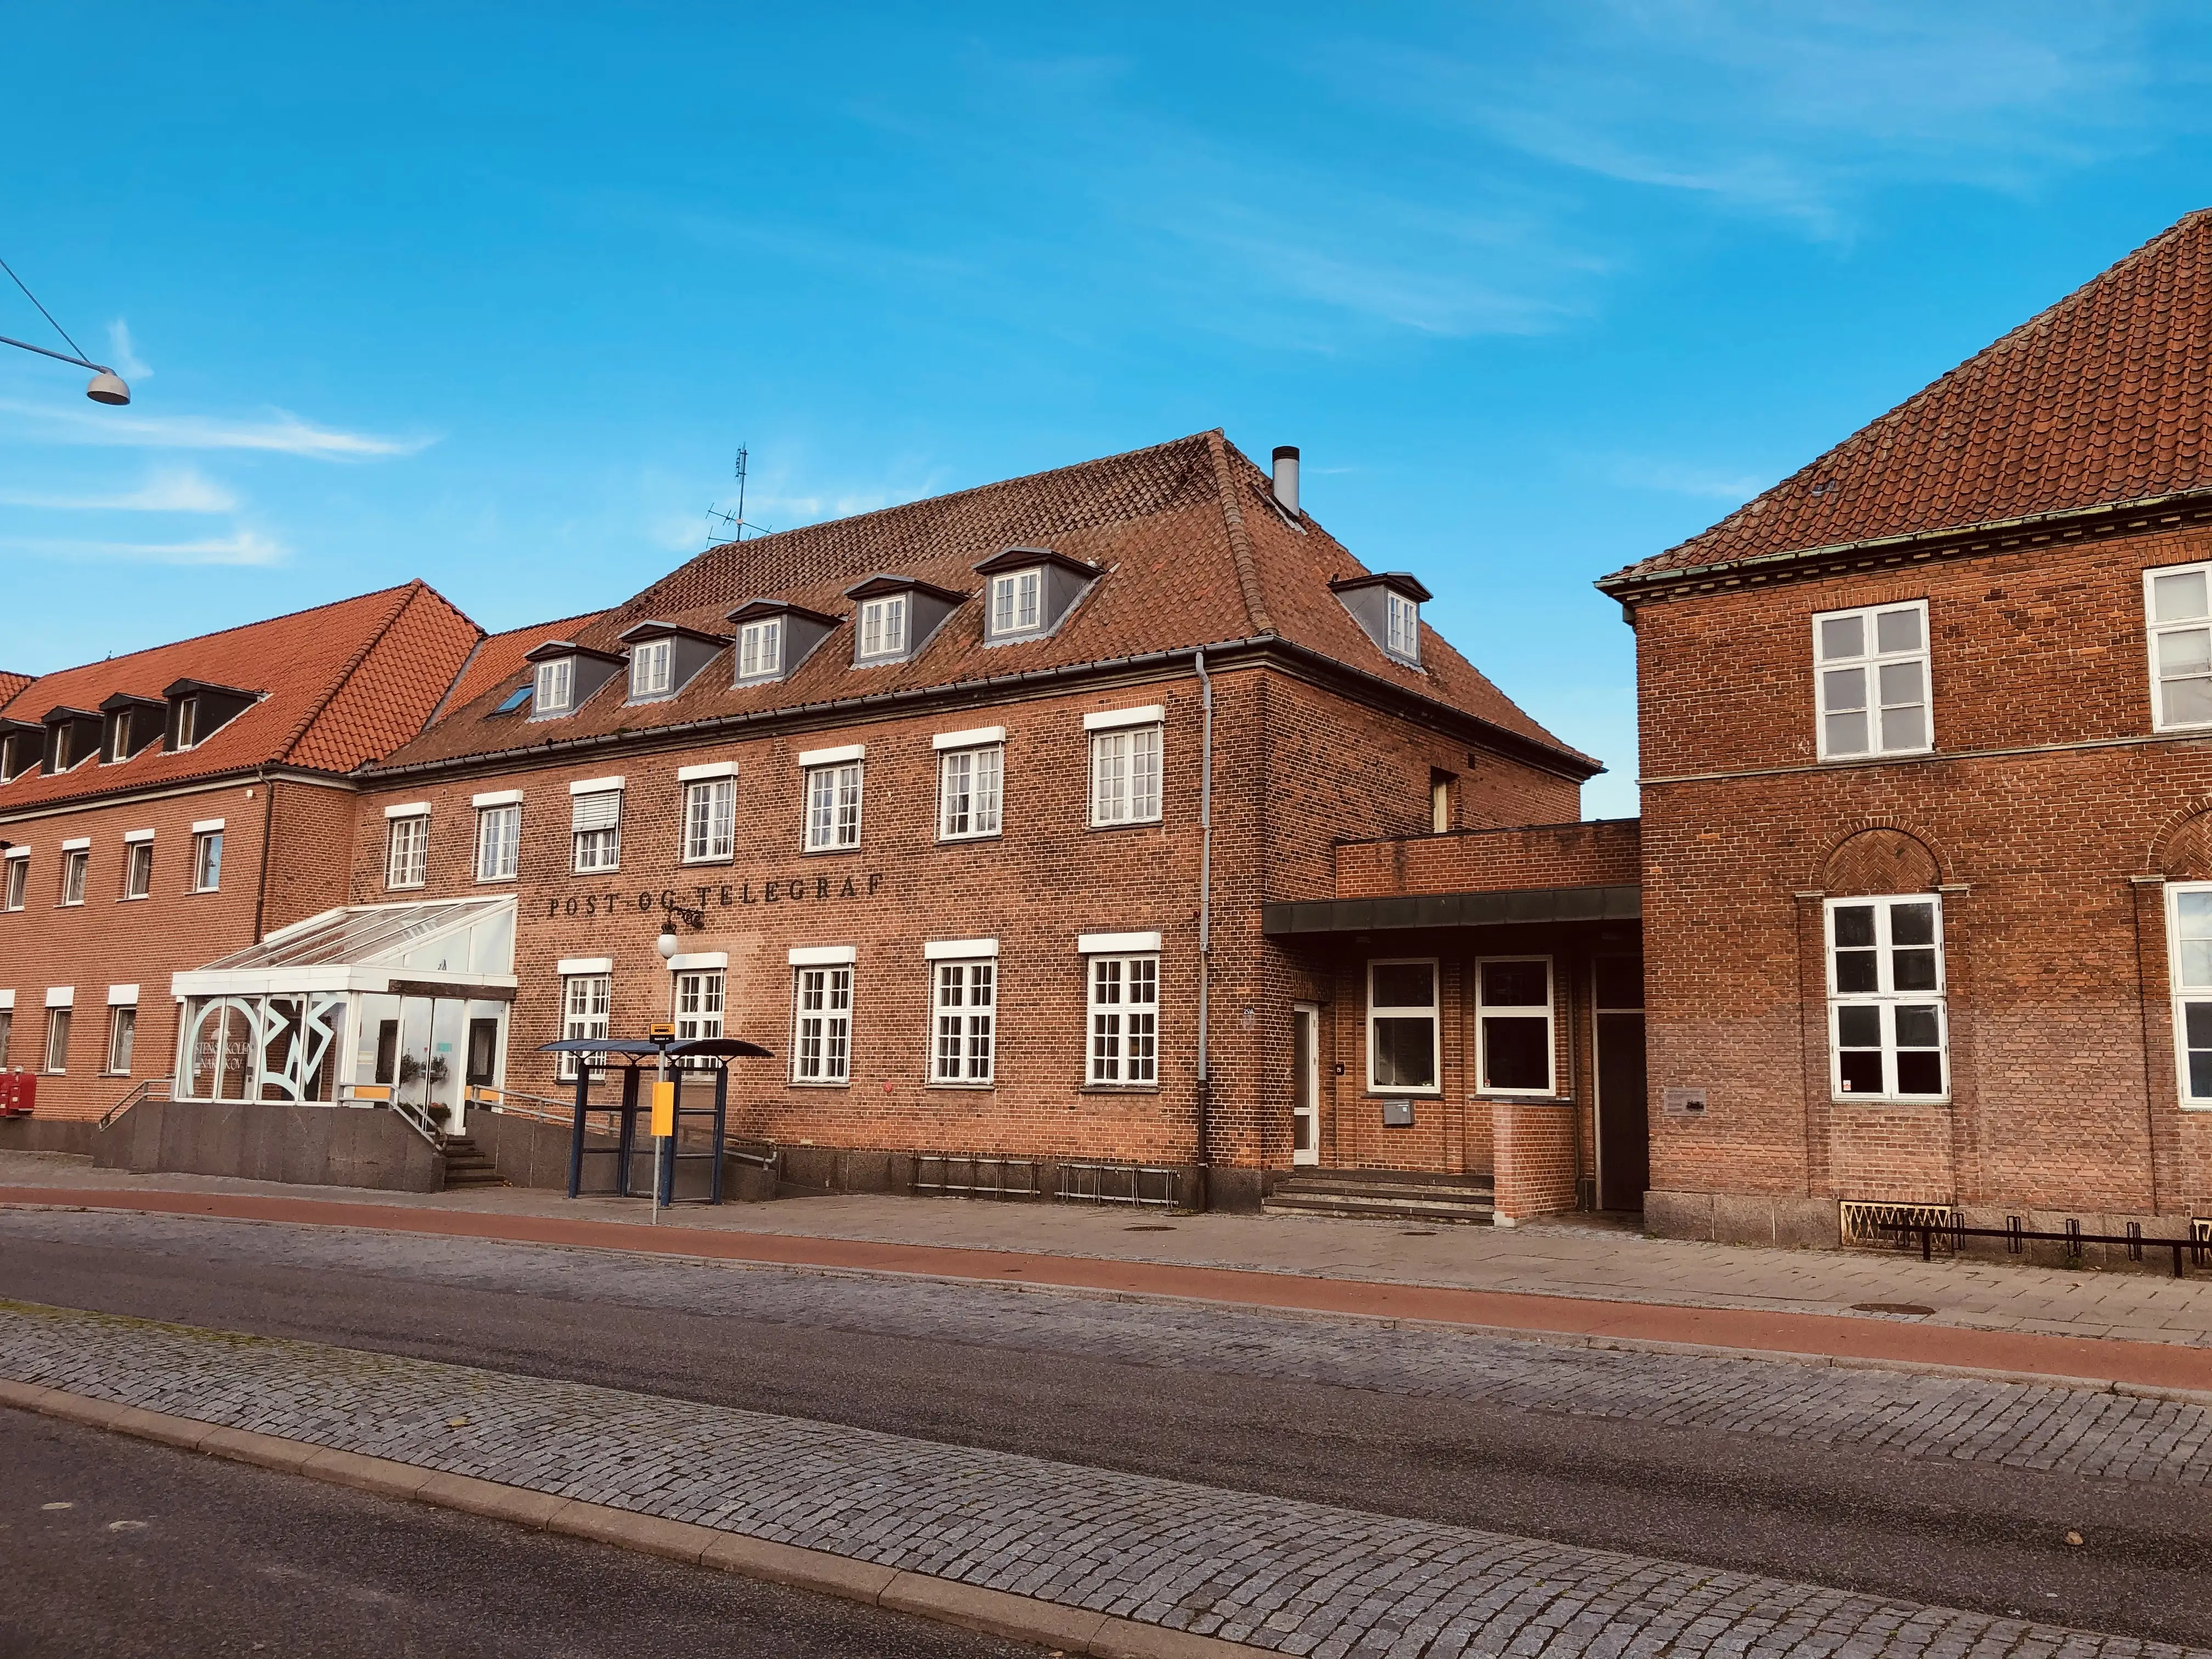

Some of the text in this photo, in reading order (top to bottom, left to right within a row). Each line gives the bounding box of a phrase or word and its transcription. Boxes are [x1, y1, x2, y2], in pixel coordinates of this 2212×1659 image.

[549, 873, 884, 917] POST OG TELEGRAF
[201, 1058, 242, 1070] NAKKOV
